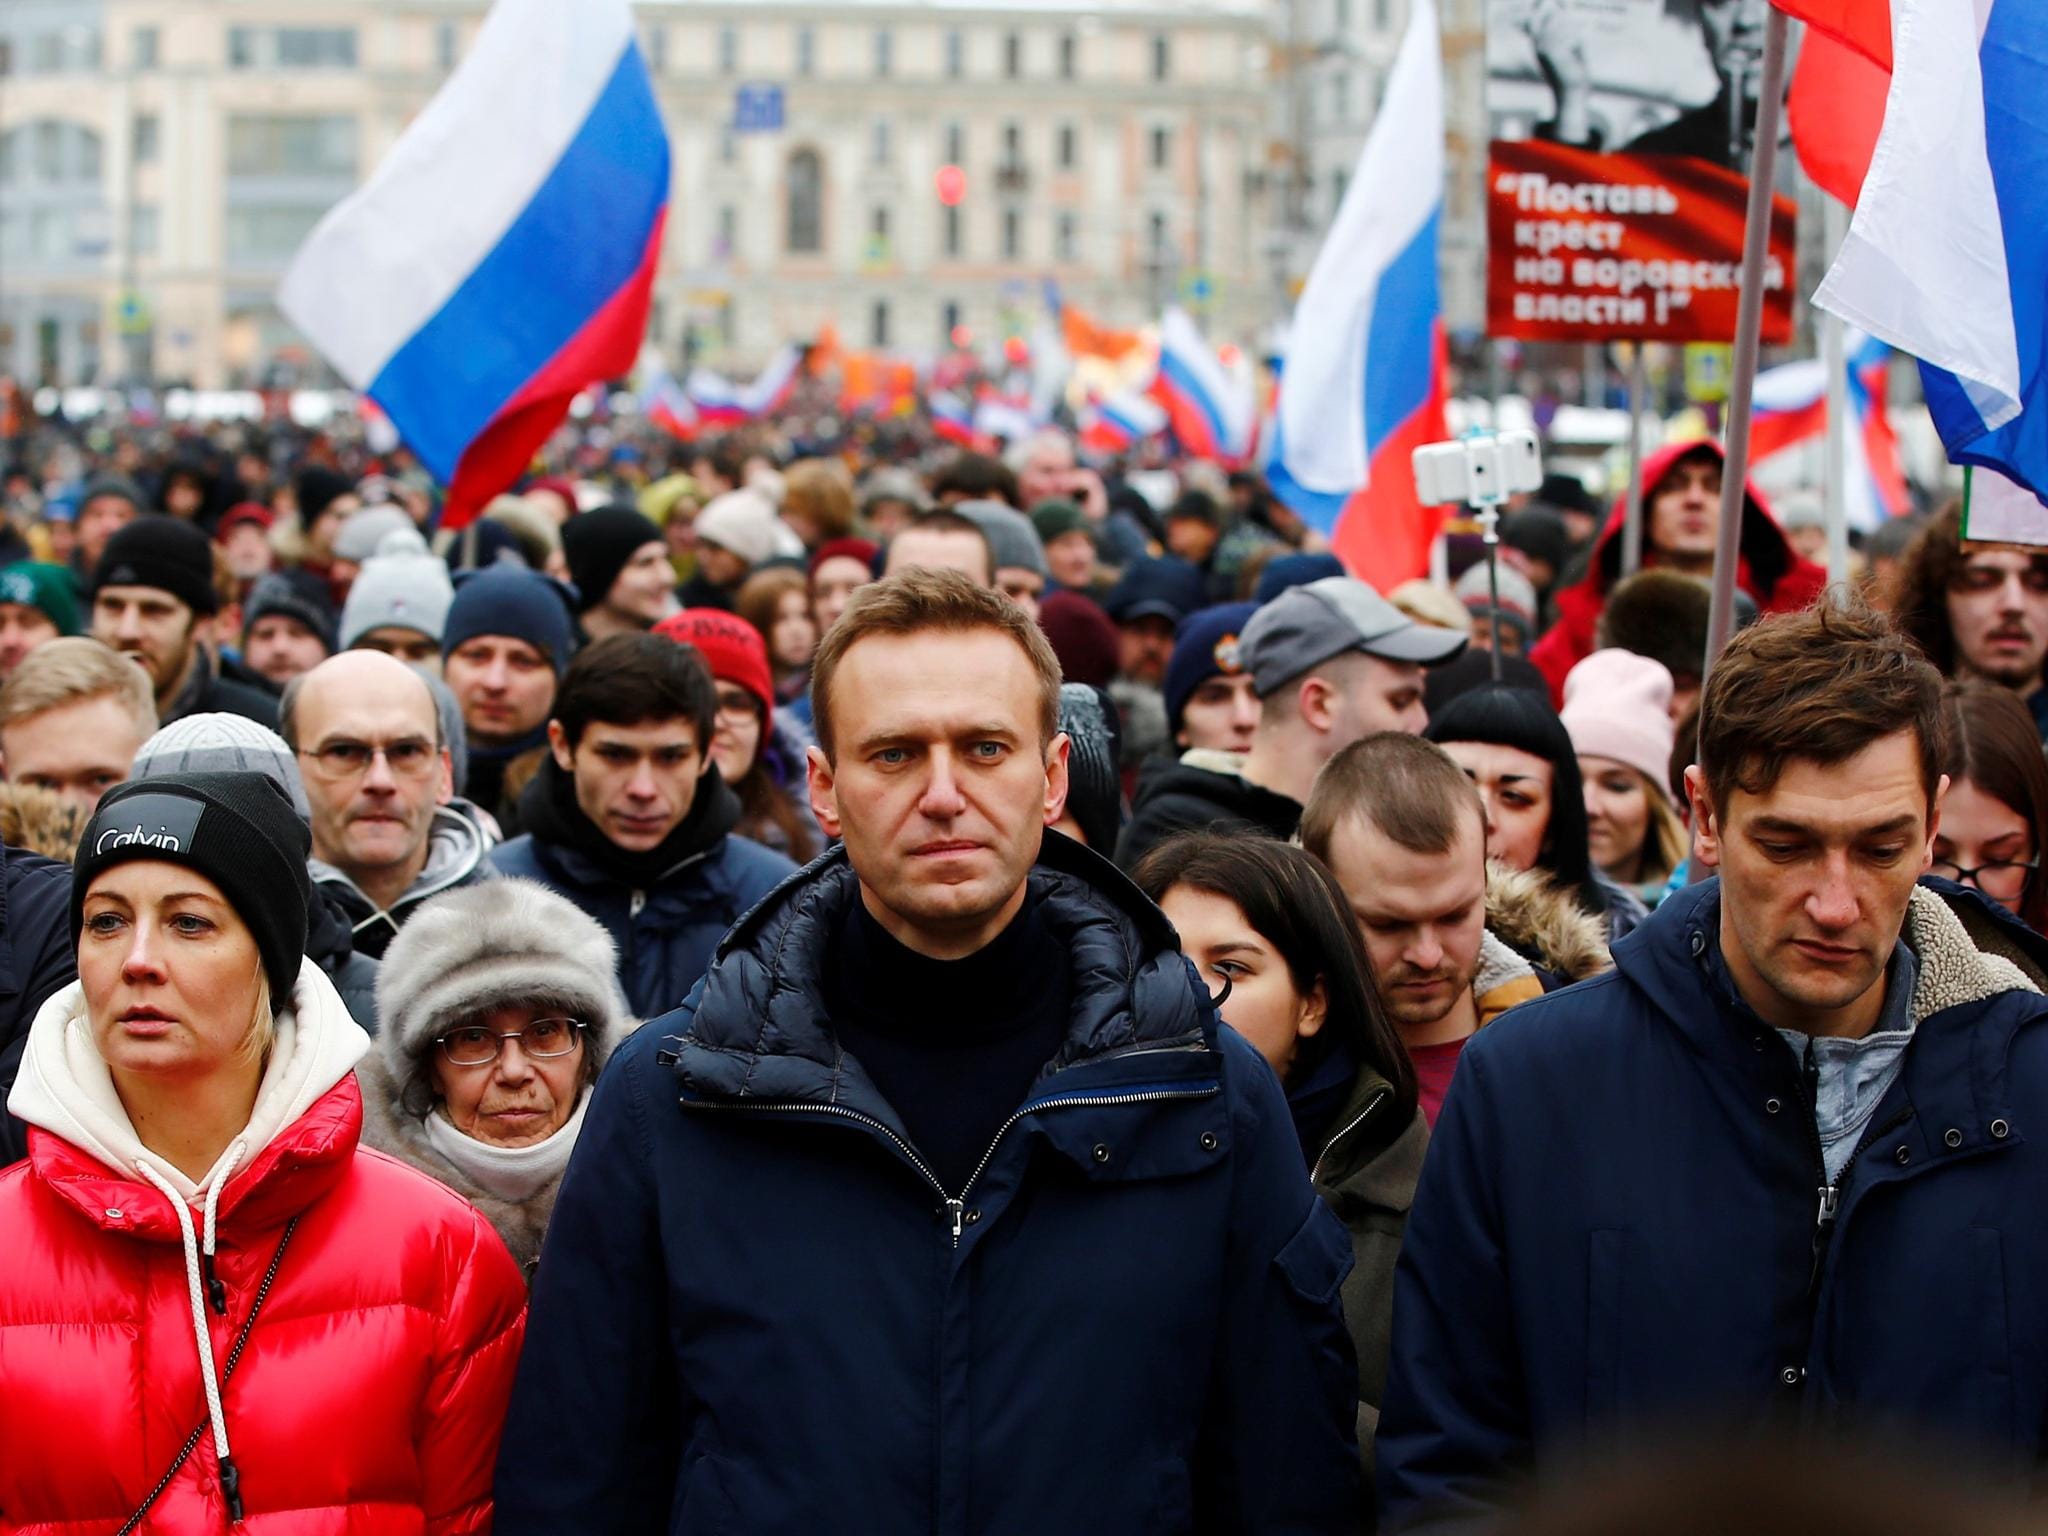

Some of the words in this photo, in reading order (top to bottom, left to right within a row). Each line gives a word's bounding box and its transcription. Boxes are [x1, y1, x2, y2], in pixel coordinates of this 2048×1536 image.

[1515, 219, 1625, 255] крест
[1515, 257, 1564, 285] на
[1514, 293, 1646, 325] власти
[97, 824, 180, 855] Calvin
